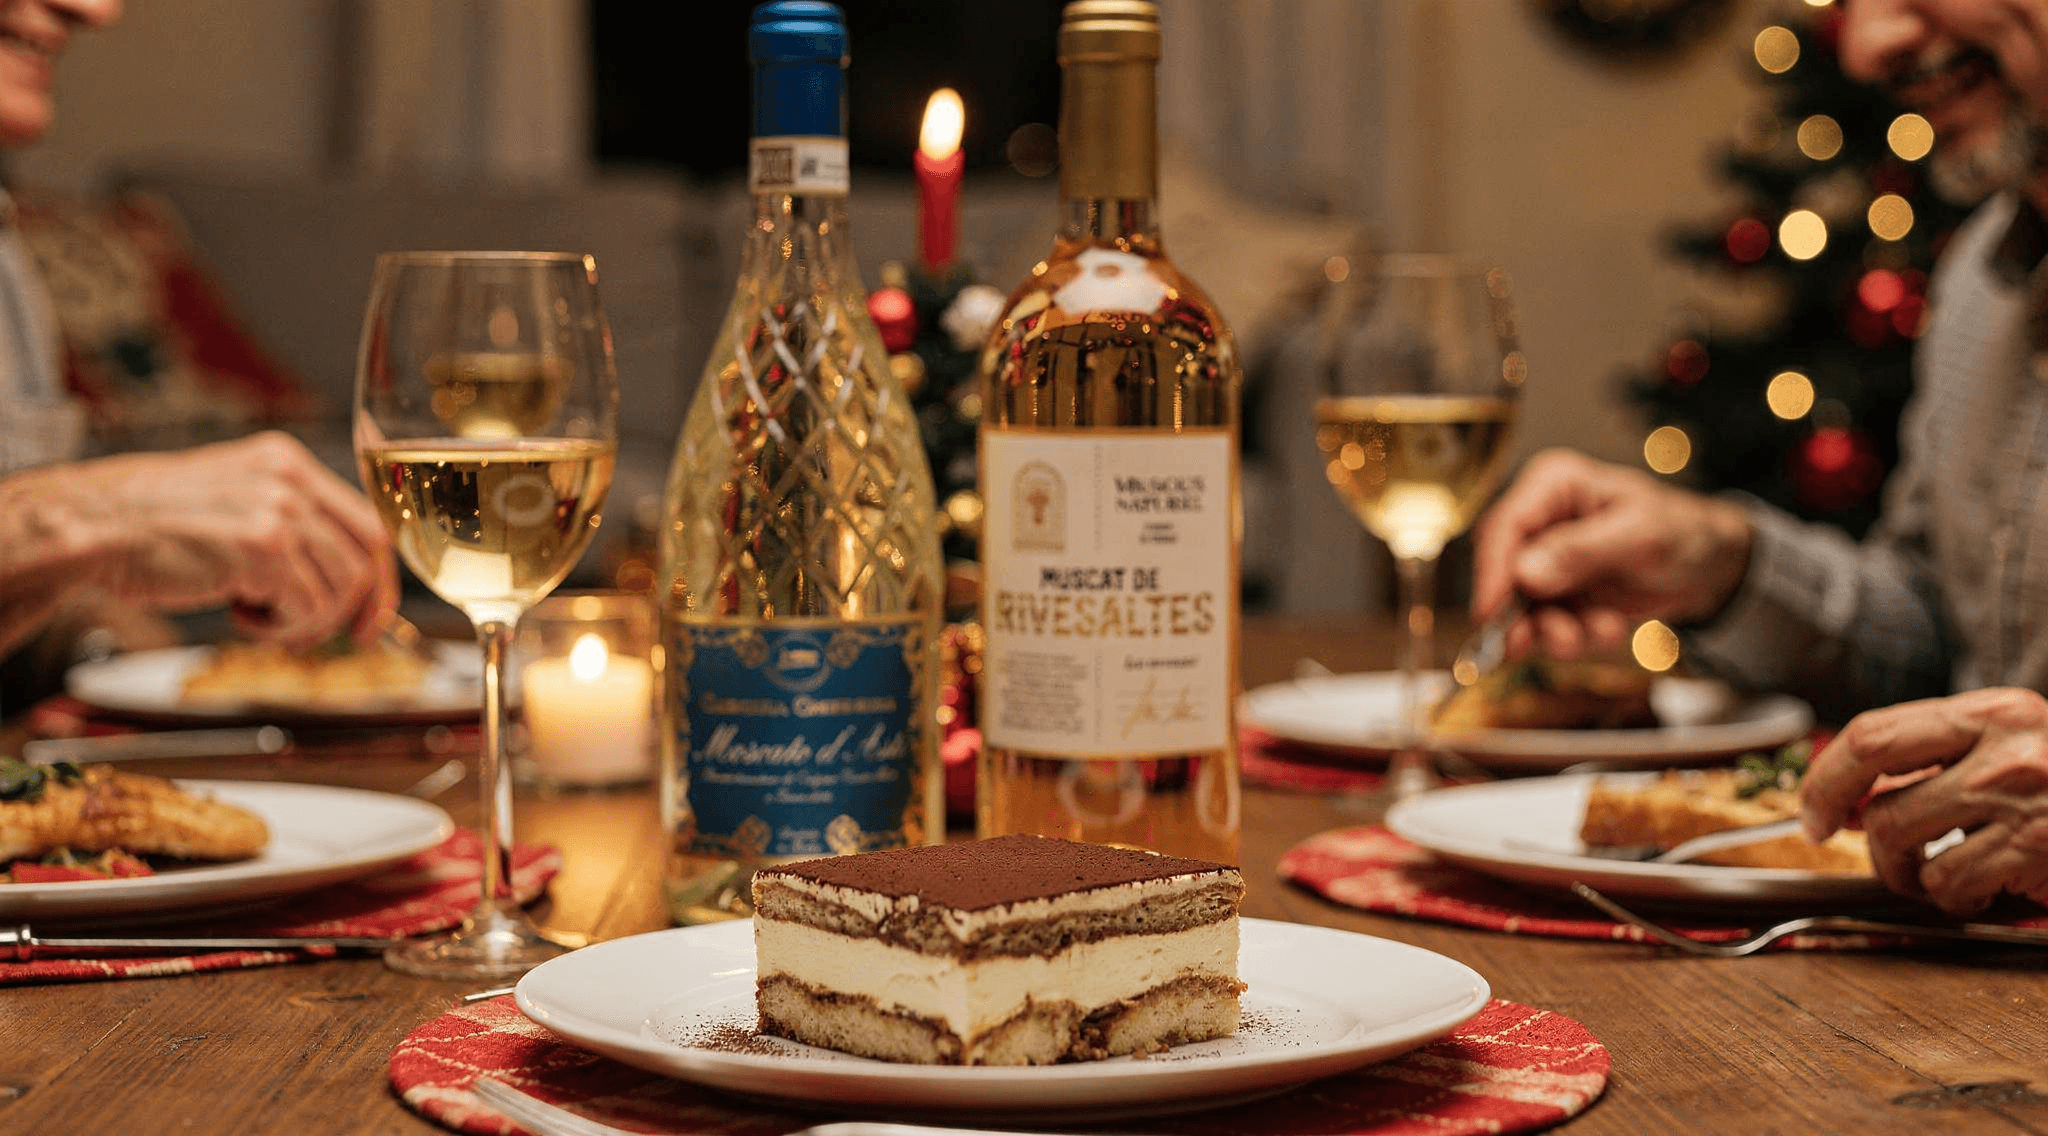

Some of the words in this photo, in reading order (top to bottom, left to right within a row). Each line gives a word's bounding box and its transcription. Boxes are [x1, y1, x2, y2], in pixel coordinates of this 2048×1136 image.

[1040, 566, 1125, 591] MUSCAT
[1132, 566, 1160, 592] DE
[995, 590, 1215, 637] RIVESALTES
